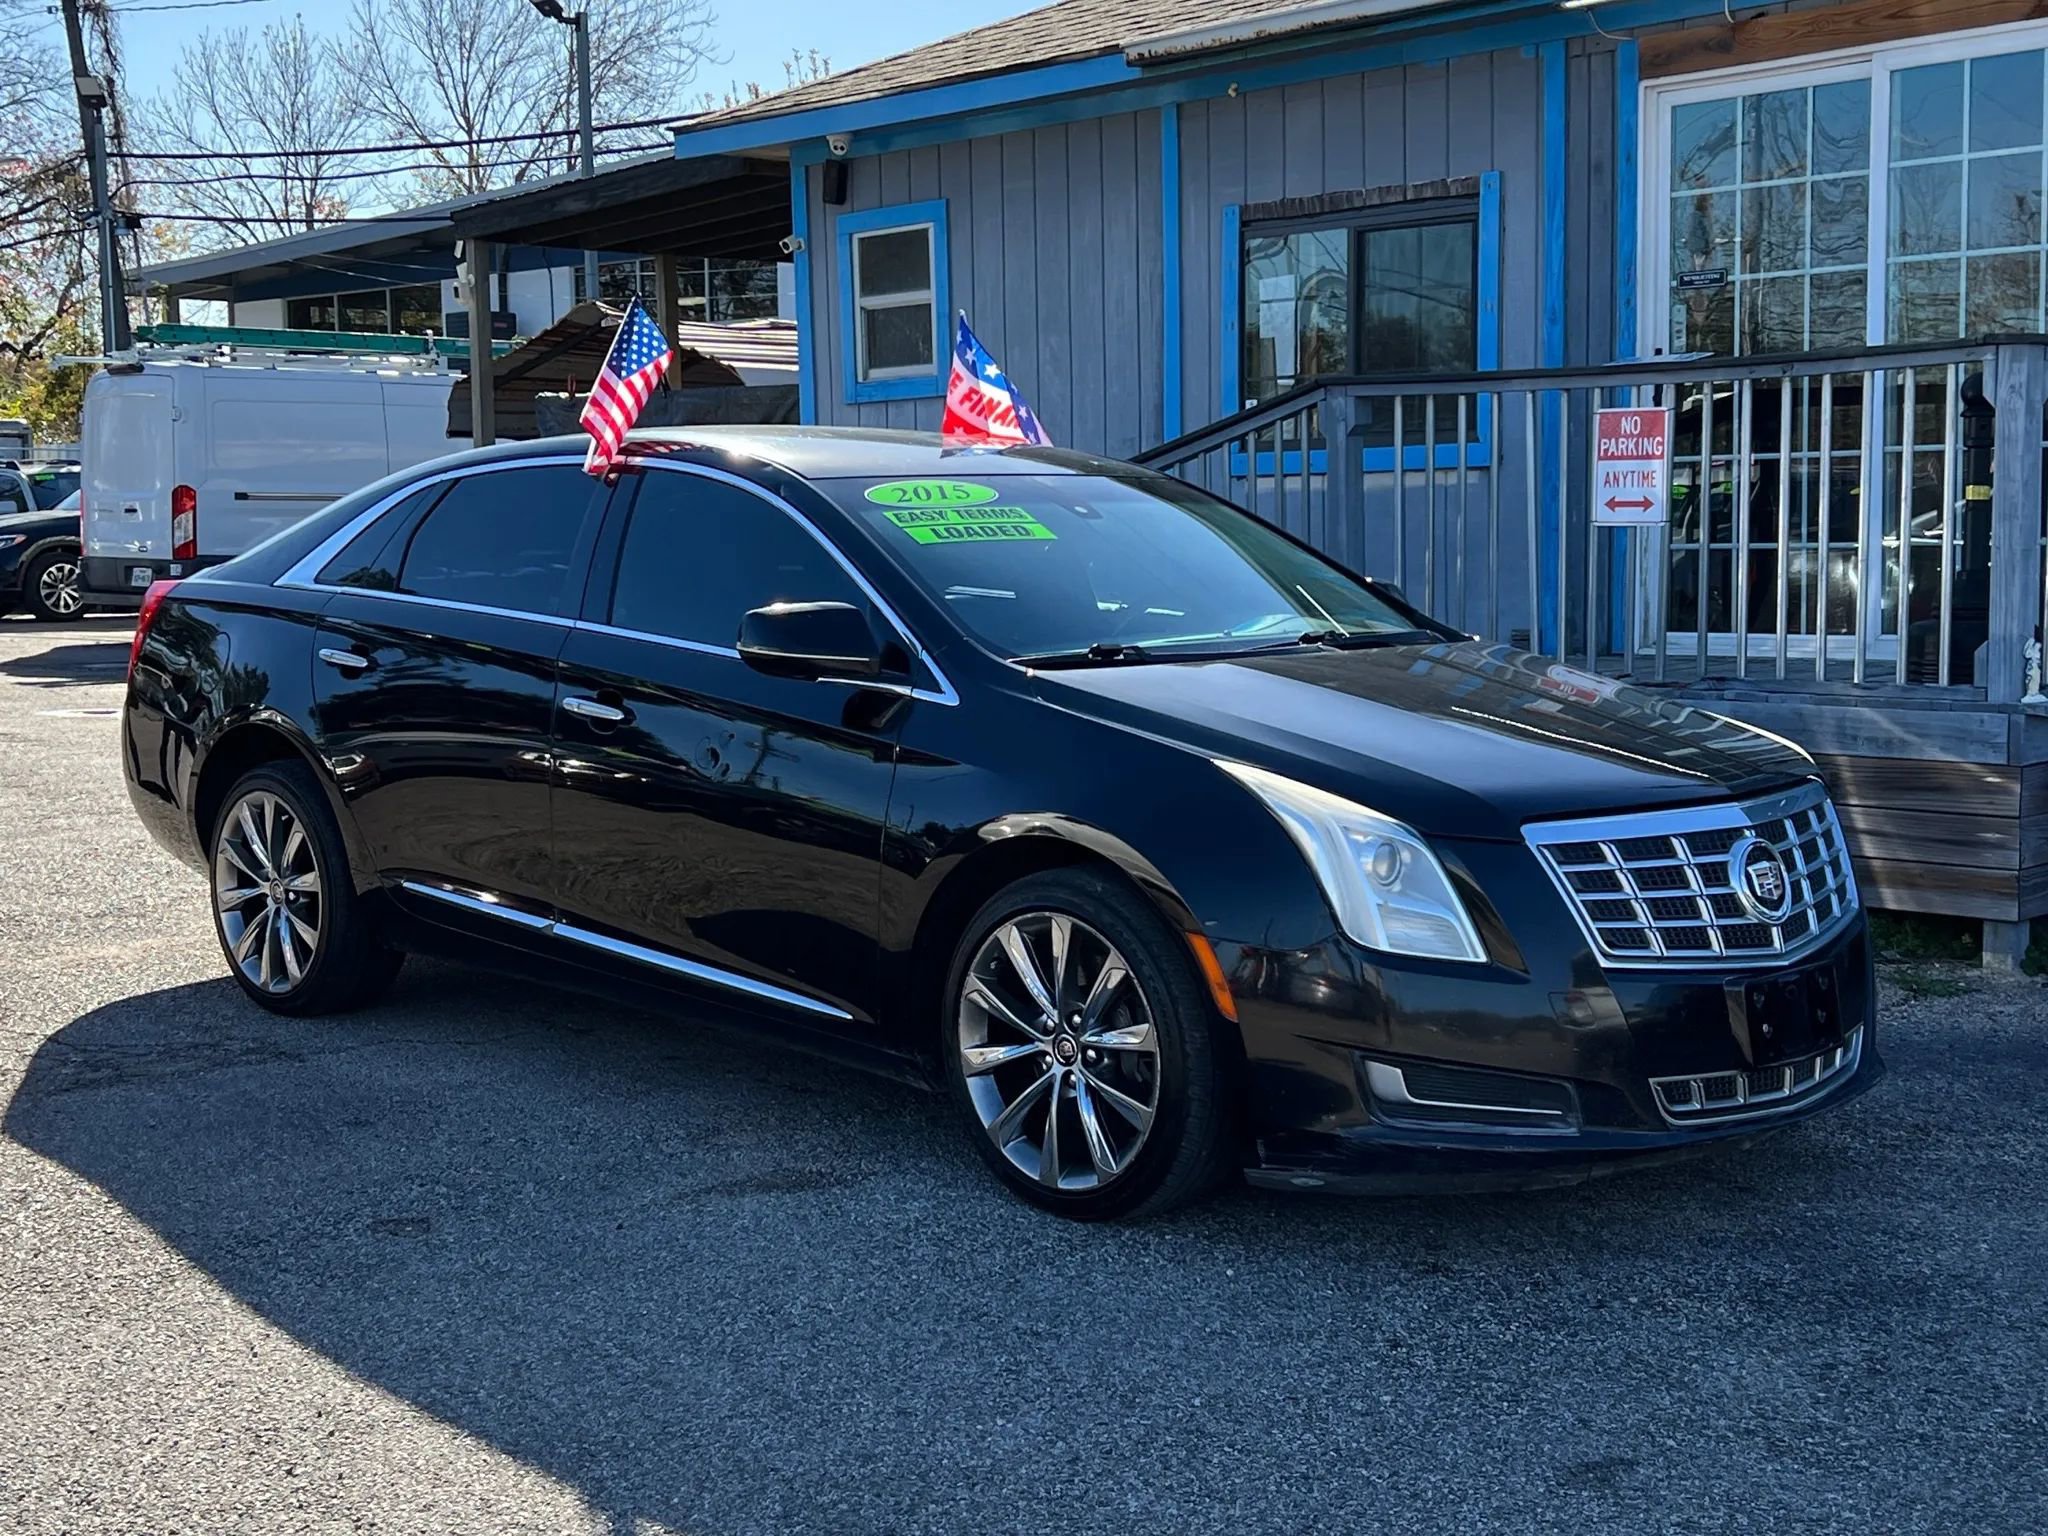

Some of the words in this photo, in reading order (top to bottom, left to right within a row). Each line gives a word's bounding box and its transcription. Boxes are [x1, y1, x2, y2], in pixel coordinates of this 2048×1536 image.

[1621, 416, 1641, 434] NO
[1600, 436, 1663, 456] PARKING
[1603, 470, 1657, 488] ANYTIME
[891, 485, 971, 503] 2015
[893, 508, 948, 523] EASY
[952, 508, 1024, 521] TERMS
[930, 525, 1033, 540] LOADED
